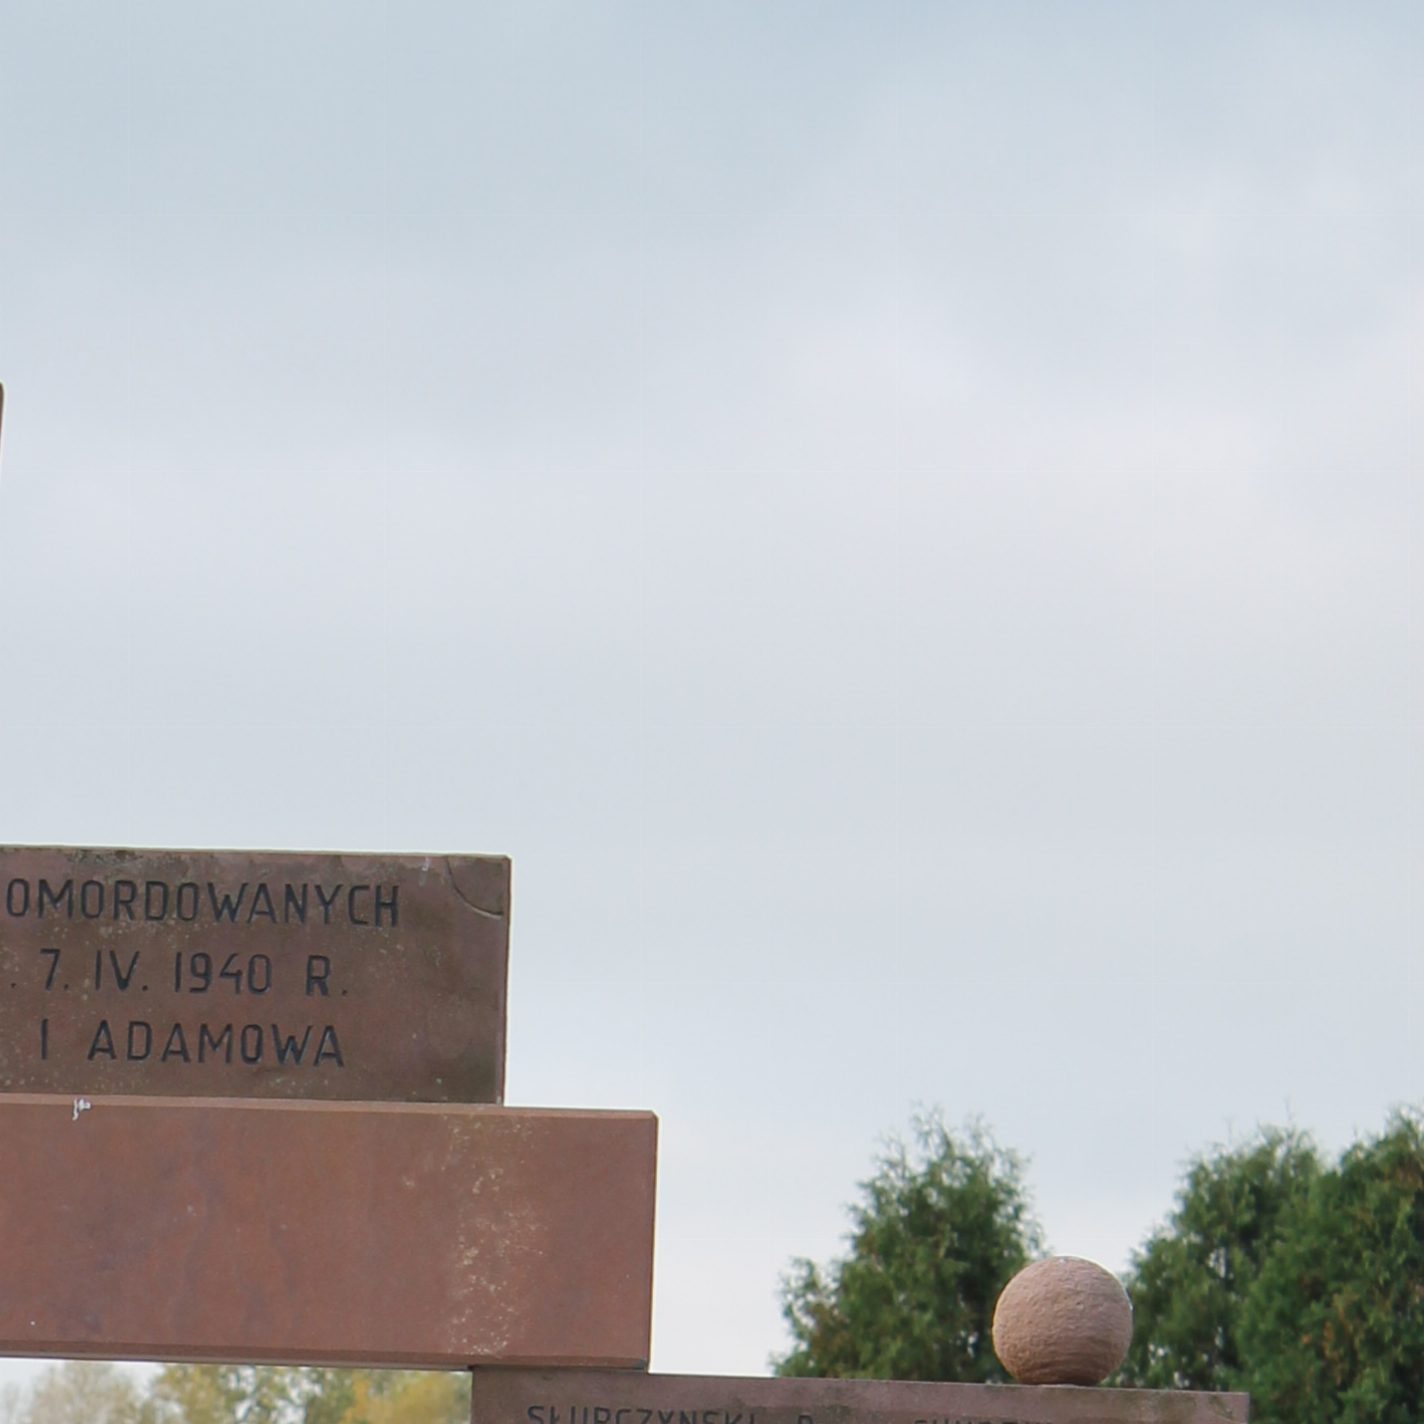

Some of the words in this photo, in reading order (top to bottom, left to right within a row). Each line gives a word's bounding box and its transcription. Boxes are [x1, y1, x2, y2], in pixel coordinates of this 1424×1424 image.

[39, 948, 70, 992] 7.
[94, 949, 150, 993] IV.
[175, 951, 273, 996] 1940
[305, 953, 349, 998] R.
[39, 1017, 50, 1061] I
[86, 1017, 345, 1068] ADAMOWA
